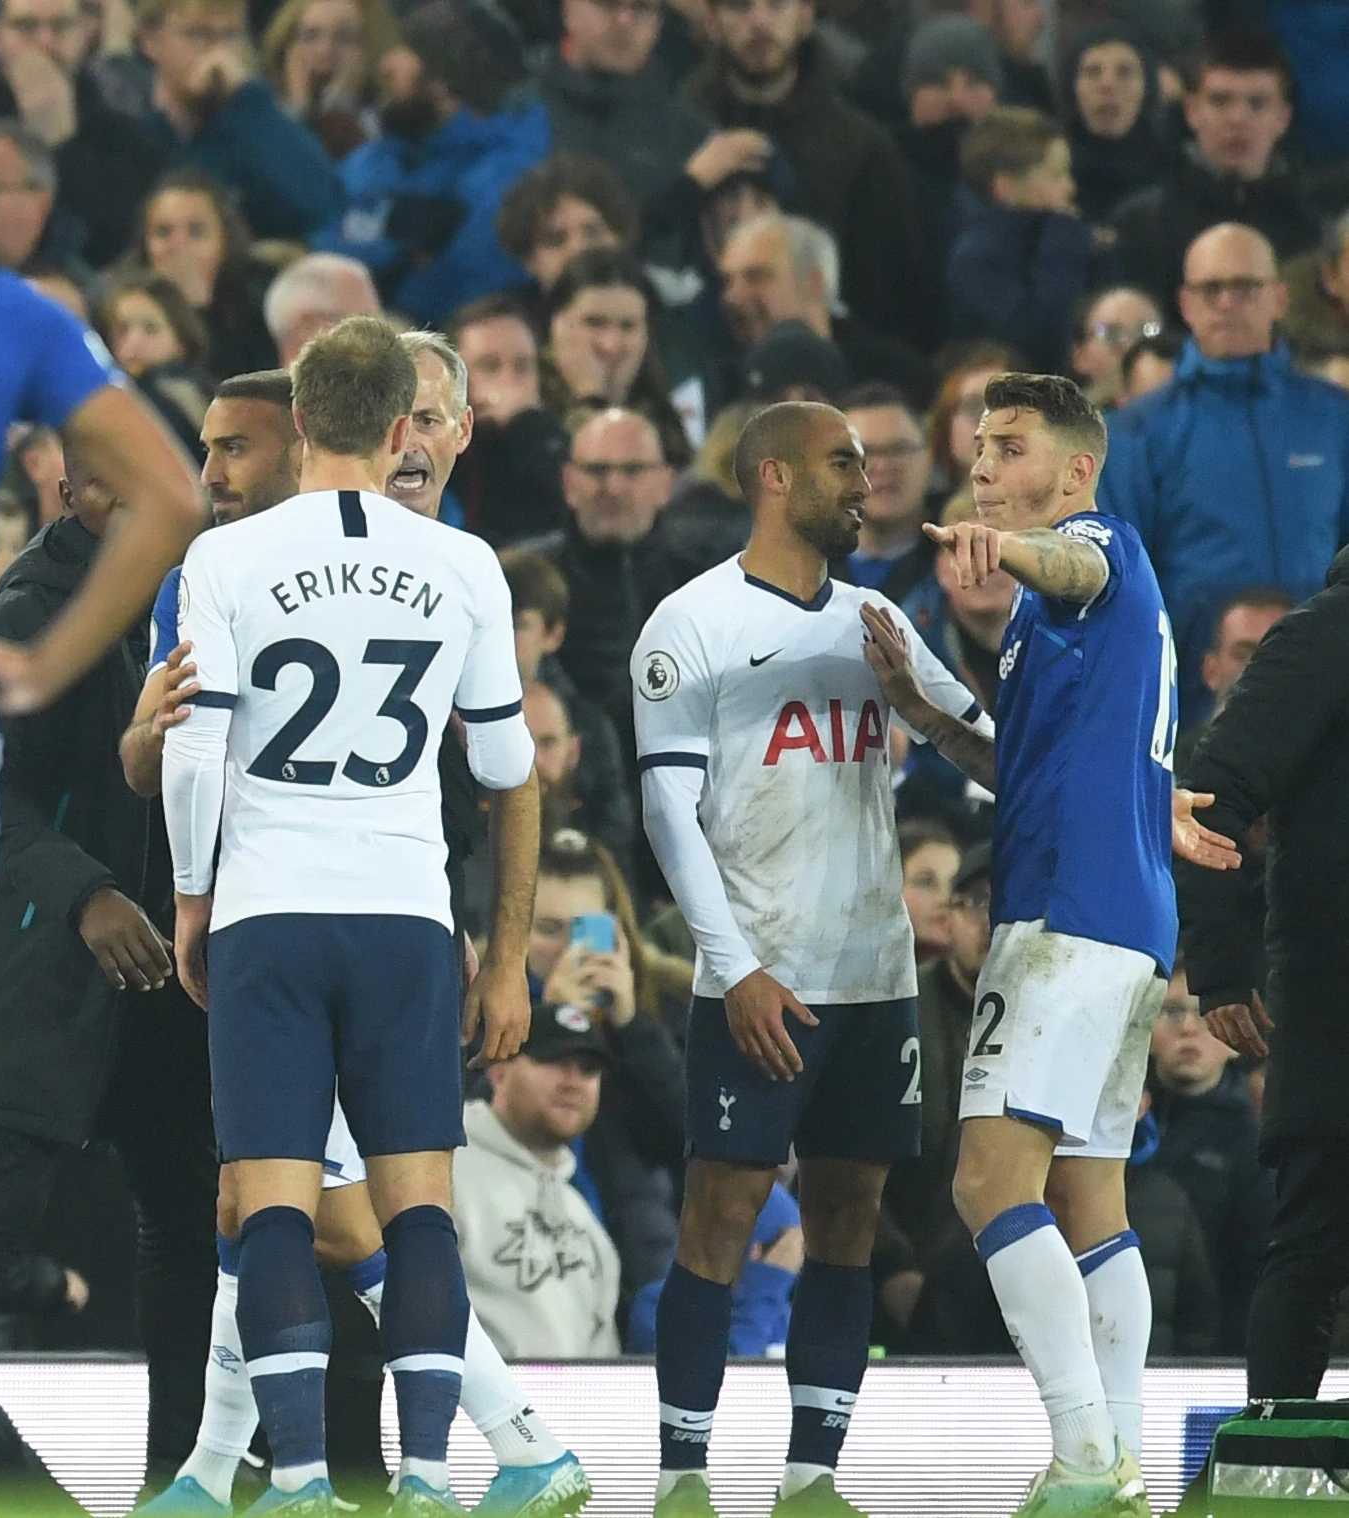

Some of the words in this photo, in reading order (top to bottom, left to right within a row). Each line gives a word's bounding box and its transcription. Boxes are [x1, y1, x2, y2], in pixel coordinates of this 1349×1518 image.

[270, 563, 443, 619] ERIKSEN
[245, 637, 443, 788] 23
[762, 698, 888, 766] AIA
[899, 1036, 922, 1105] 2
